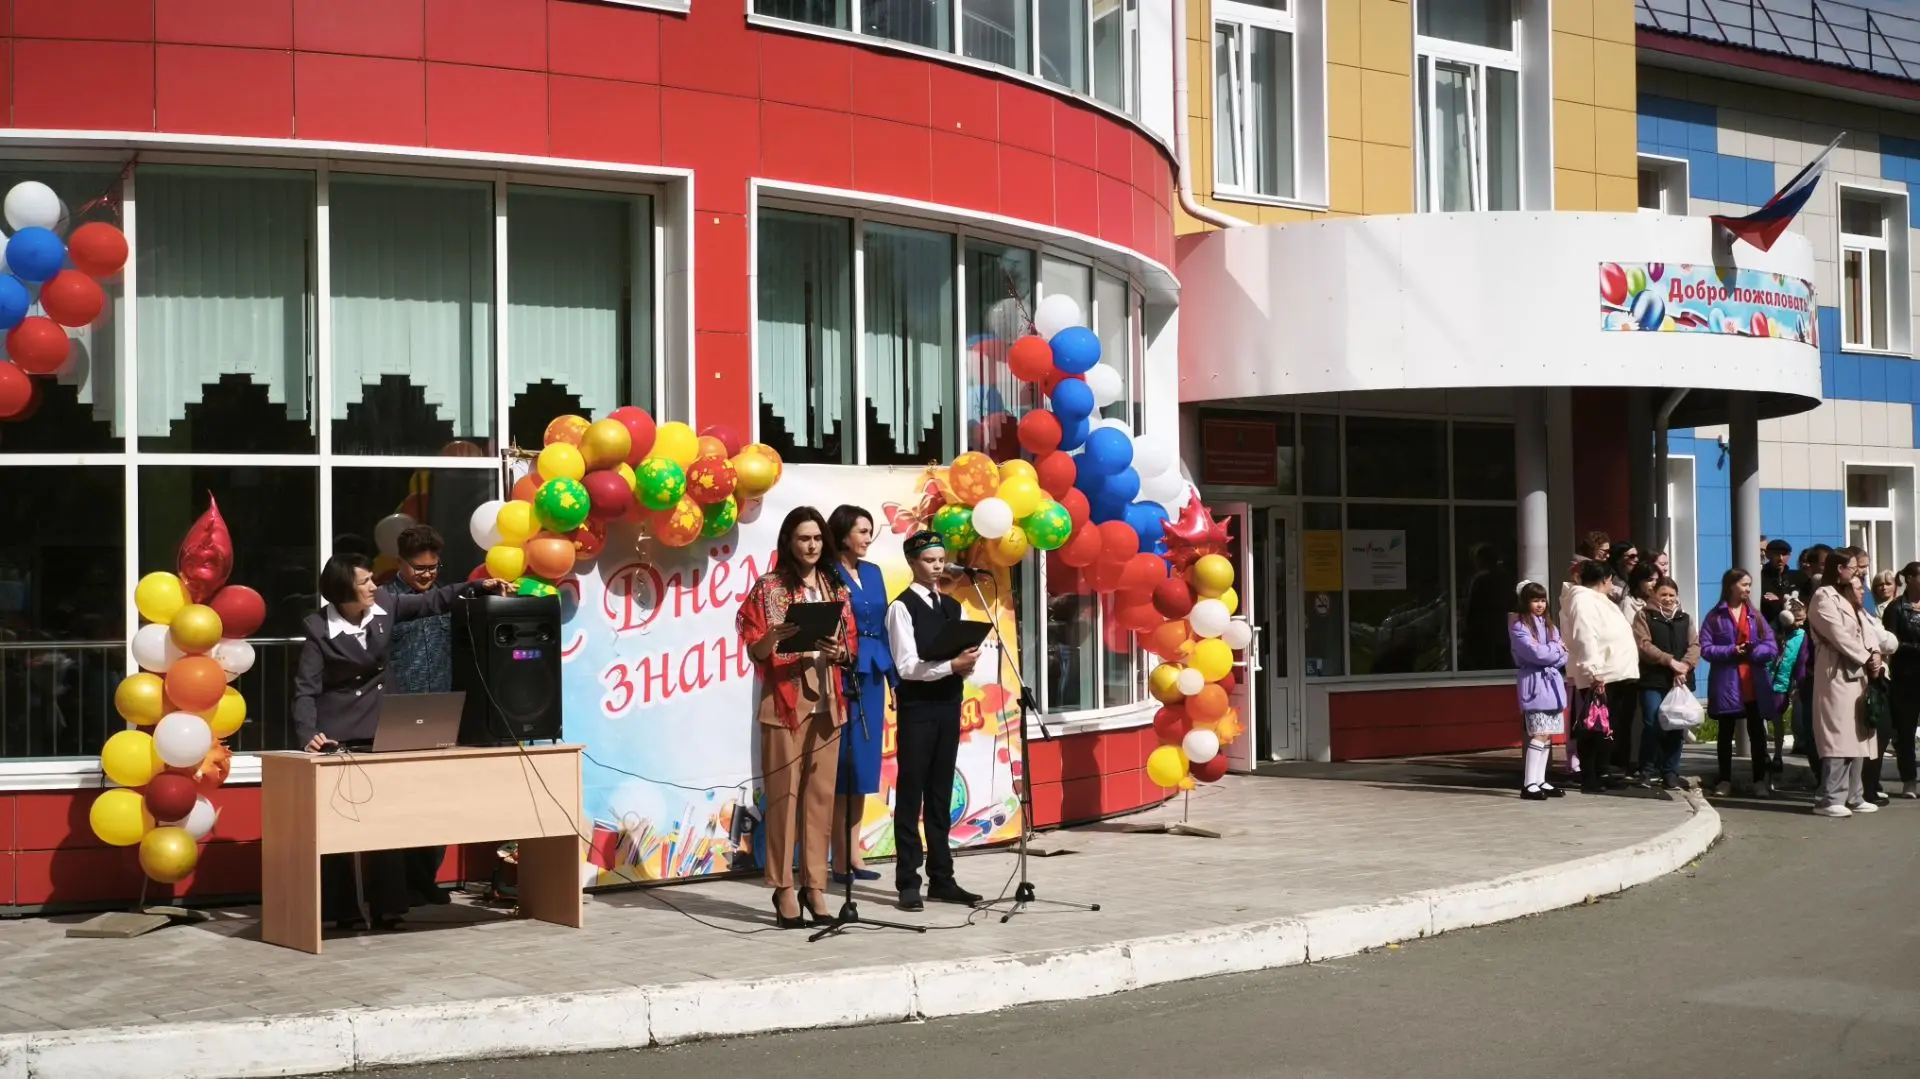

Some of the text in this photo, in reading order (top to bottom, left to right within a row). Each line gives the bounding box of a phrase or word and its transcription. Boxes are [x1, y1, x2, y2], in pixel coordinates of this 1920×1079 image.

[1668, 277, 1728, 306] Добро
[603, 544, 778, 632] Днём
[604, 635, 752, 713] знан
